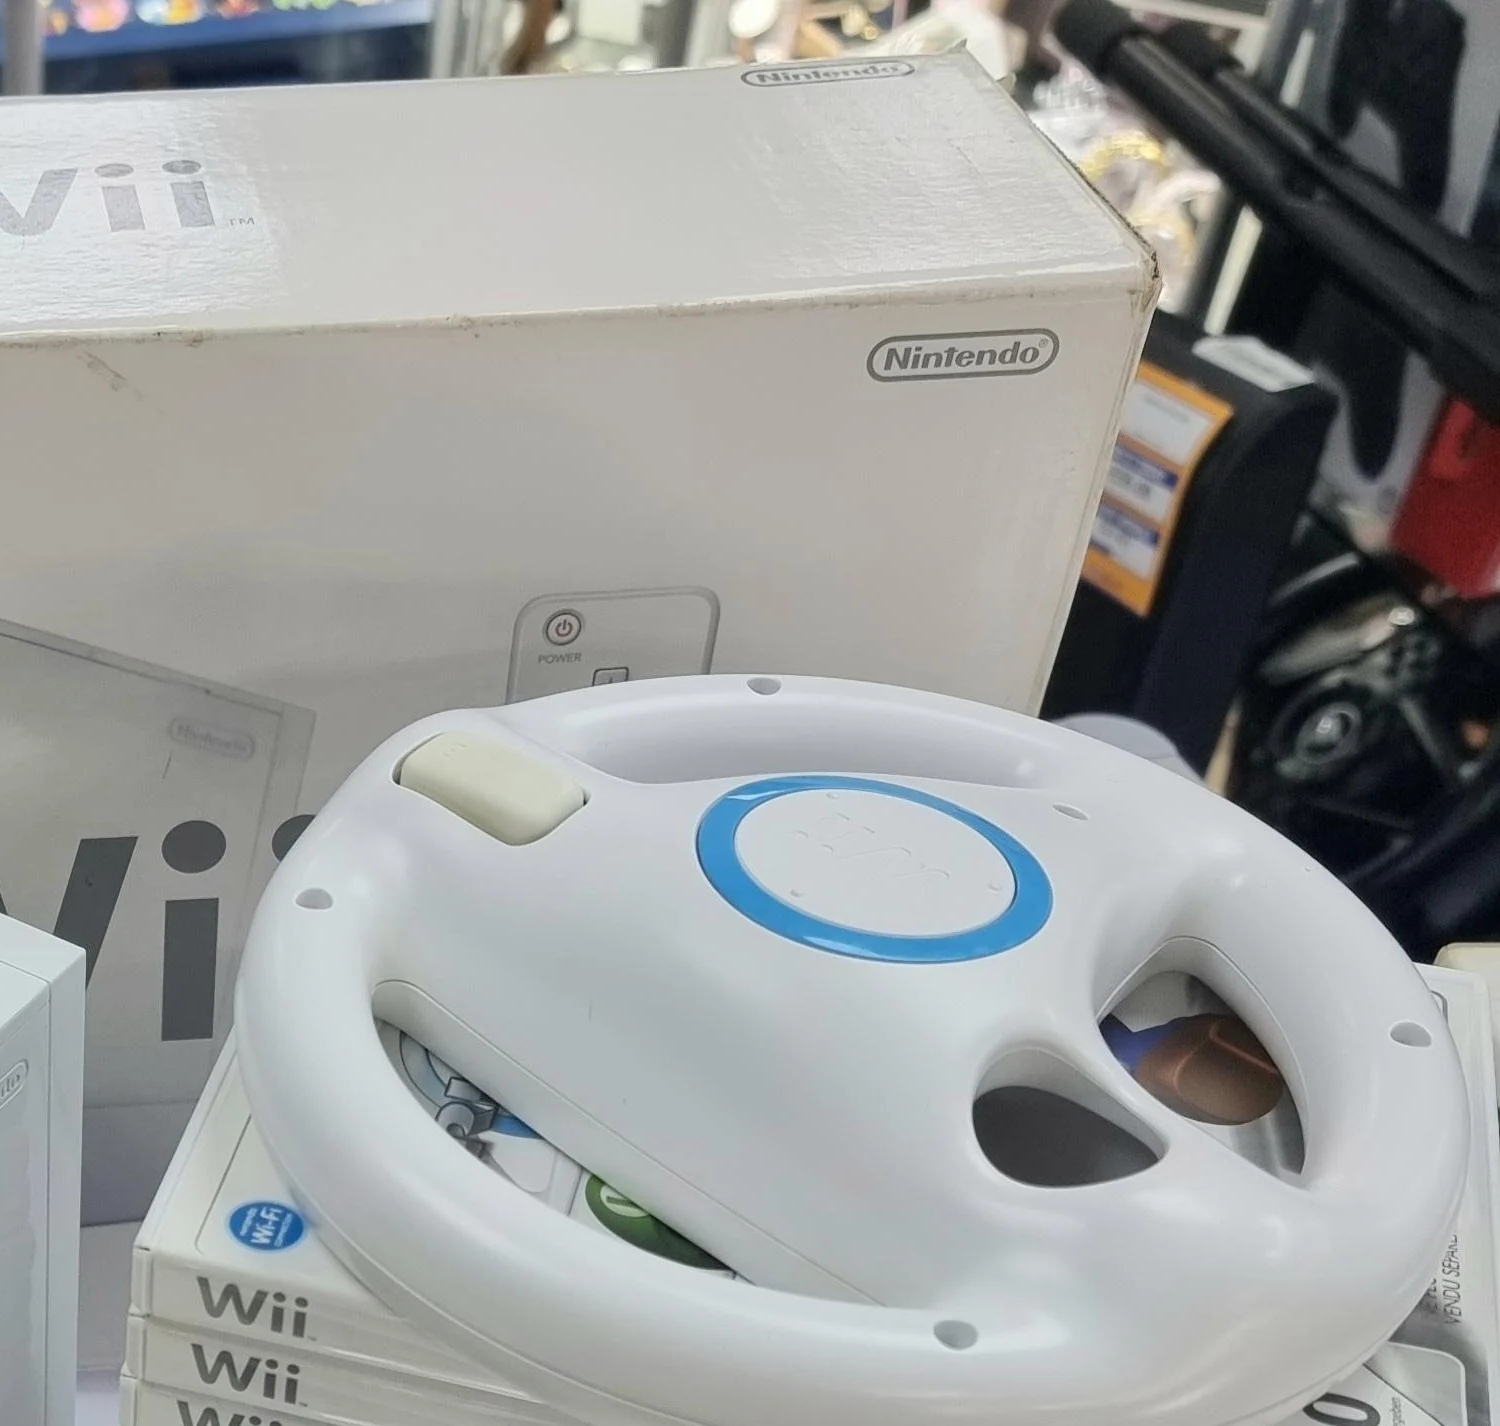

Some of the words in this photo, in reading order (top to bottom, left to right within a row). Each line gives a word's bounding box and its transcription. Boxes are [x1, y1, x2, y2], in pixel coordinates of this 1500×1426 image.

[756, 64, 900, 83] Nintendo
[537, 650, 583, 665] POWER
[197, 1276, 309, 1339] Wii
[1443, 1279, 1462, 1324] VENDU
[191, 1343, 300, 1405] Wii
